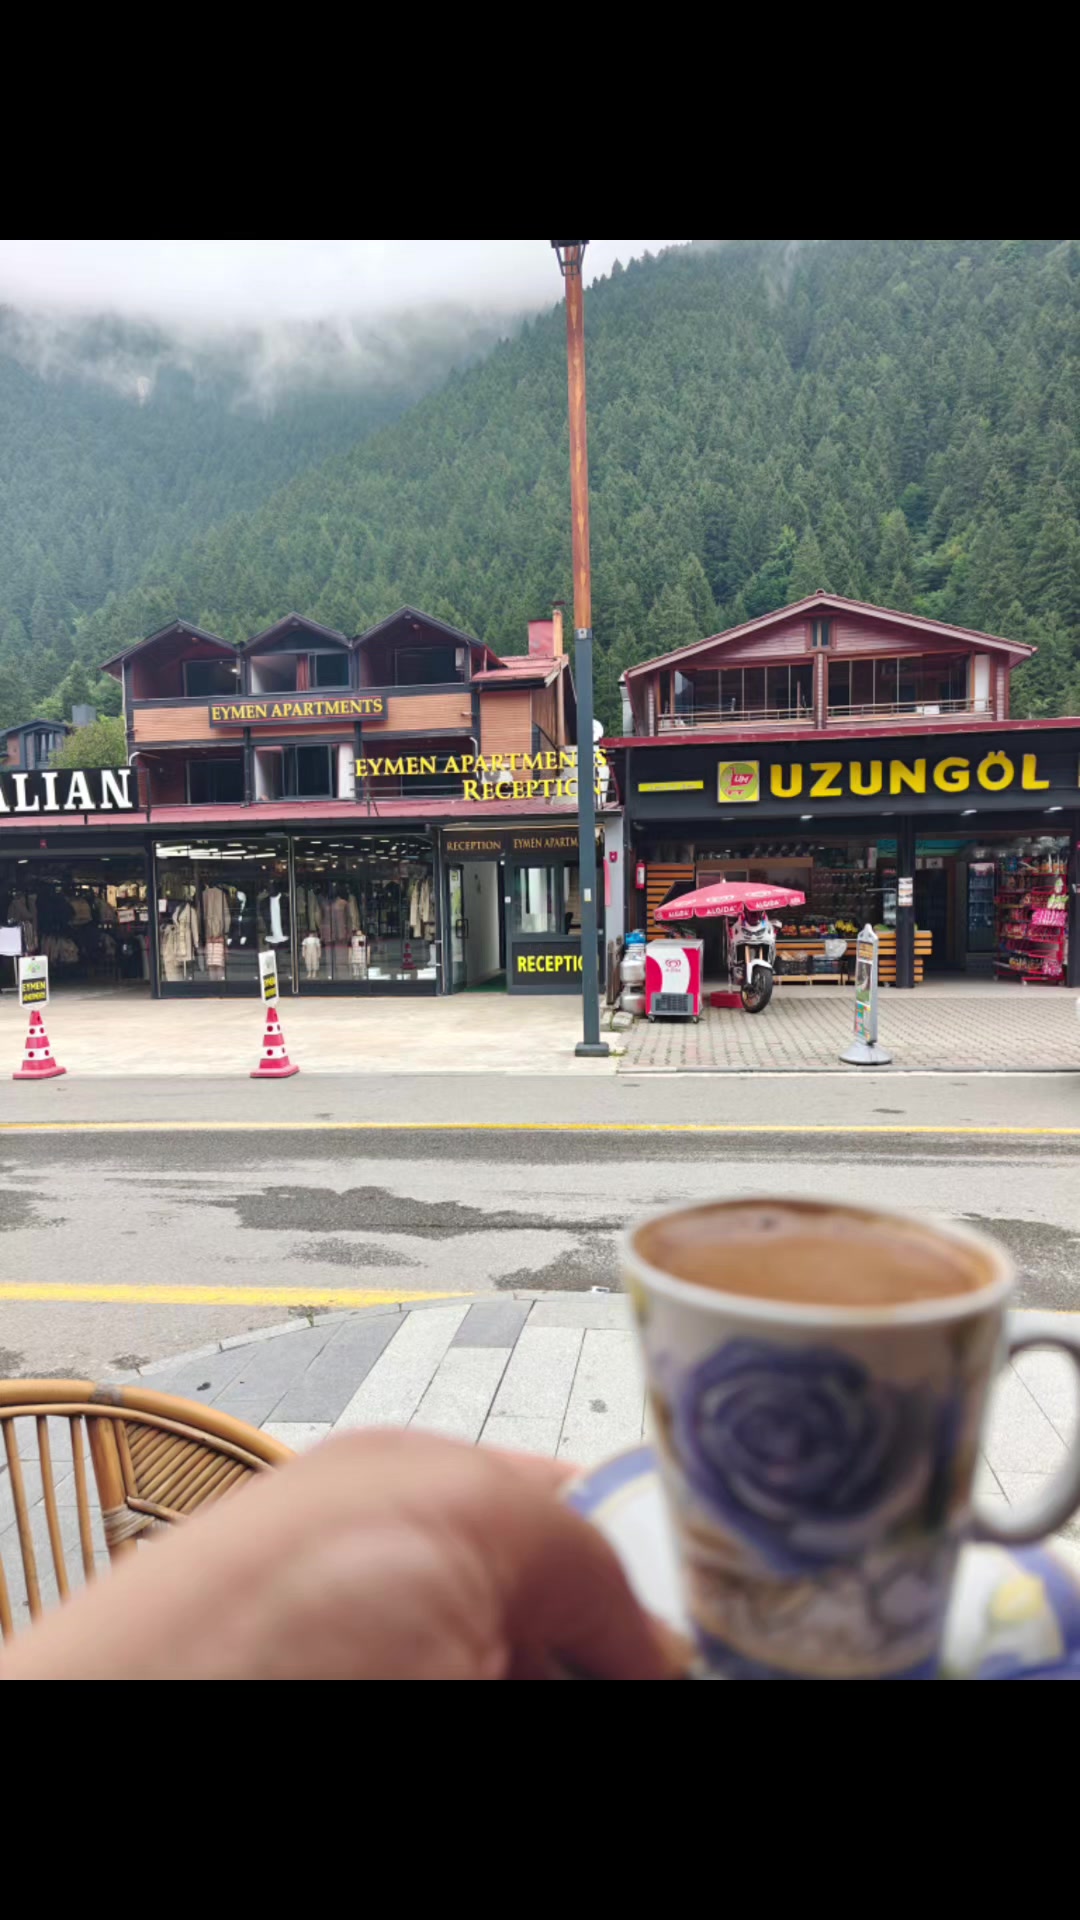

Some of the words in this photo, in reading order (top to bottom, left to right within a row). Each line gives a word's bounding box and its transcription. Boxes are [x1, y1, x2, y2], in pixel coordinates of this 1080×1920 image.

[212, 704, 267, 720] EYMEN
[271, 699, 383, 717] APARTMENTS
[355, 756, 437, 776] EYMEN
[442, 748, 607, 773] APARTMENS
[770, 750, 1050, 798] UZUNGÖL
[447, 841, 501, 850] RECEPTION
[514, 838, 543, 848] EYMEN
